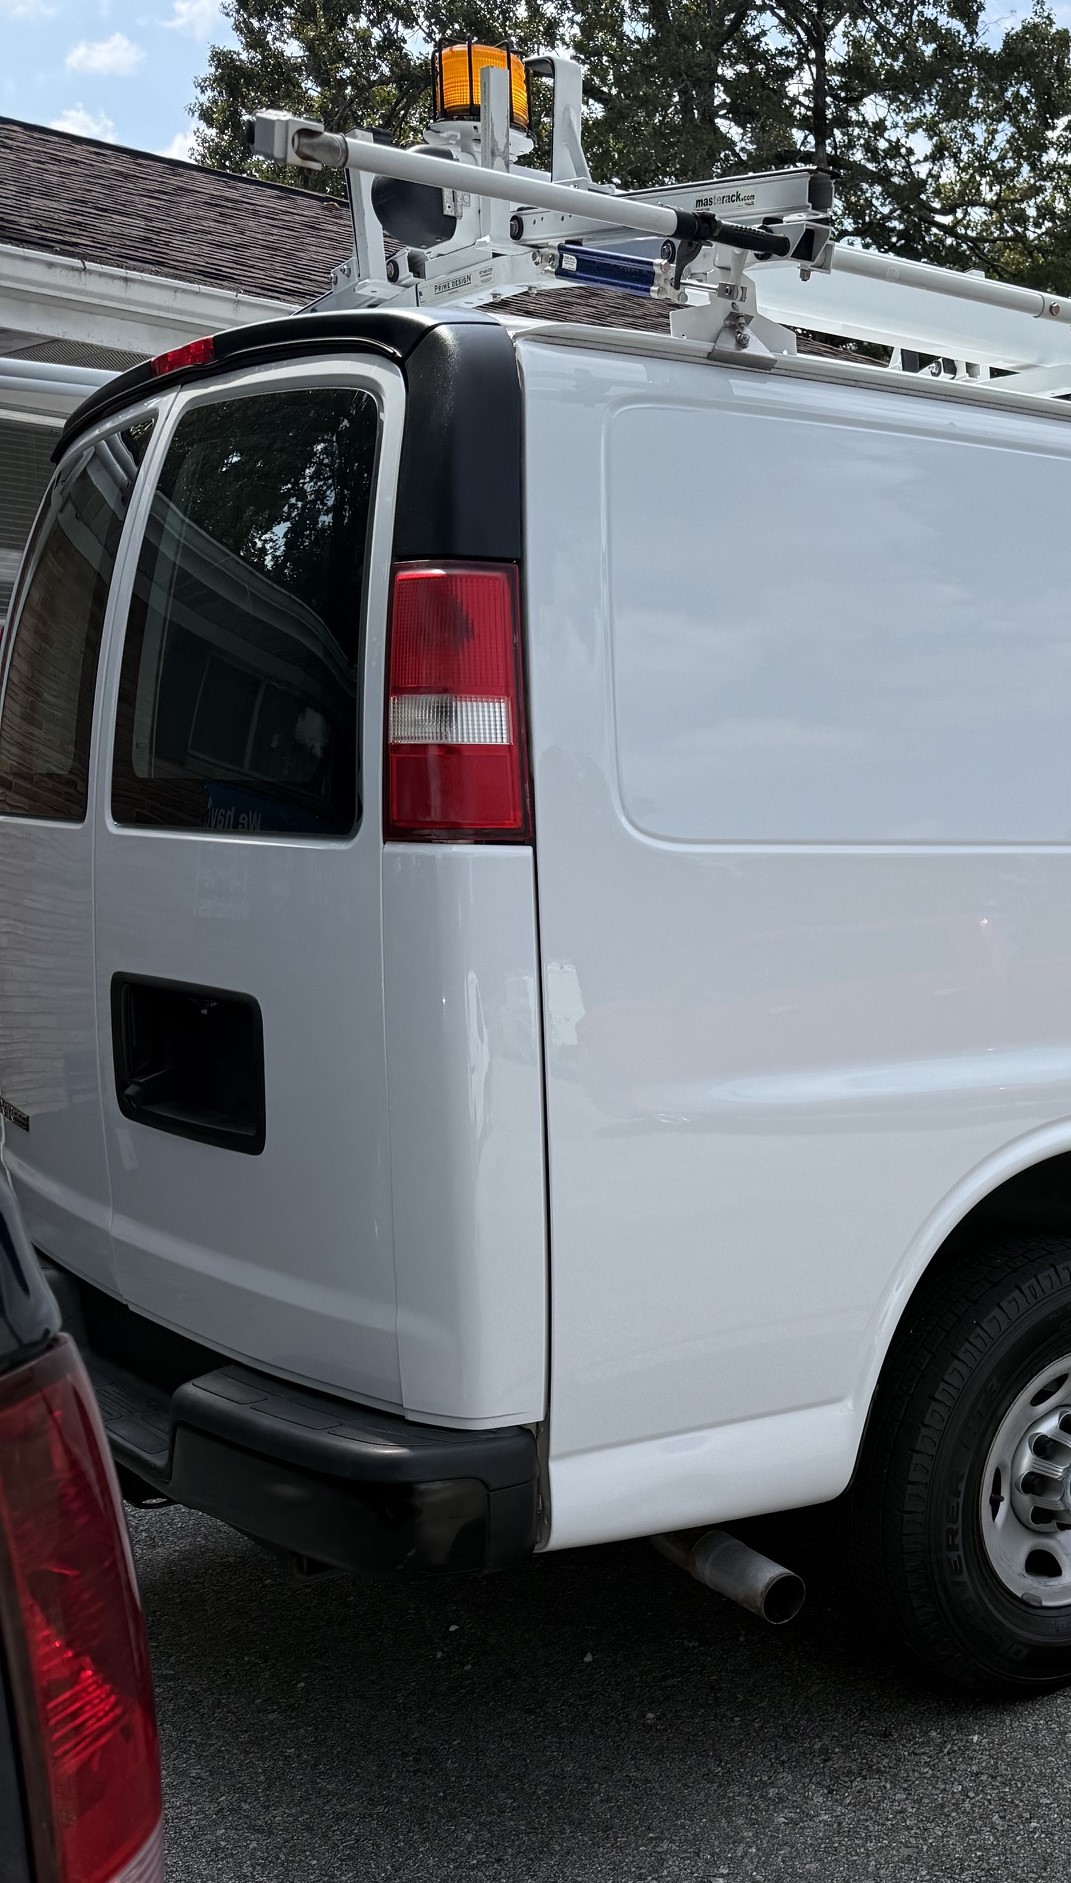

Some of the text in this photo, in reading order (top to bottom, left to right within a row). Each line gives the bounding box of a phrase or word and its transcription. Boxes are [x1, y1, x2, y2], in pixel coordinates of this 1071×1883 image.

[695, 190, 756, 208] masterack.com
[434, 282, 451, 293] PRIME
[451, 274, 472, 289] DESIGN
